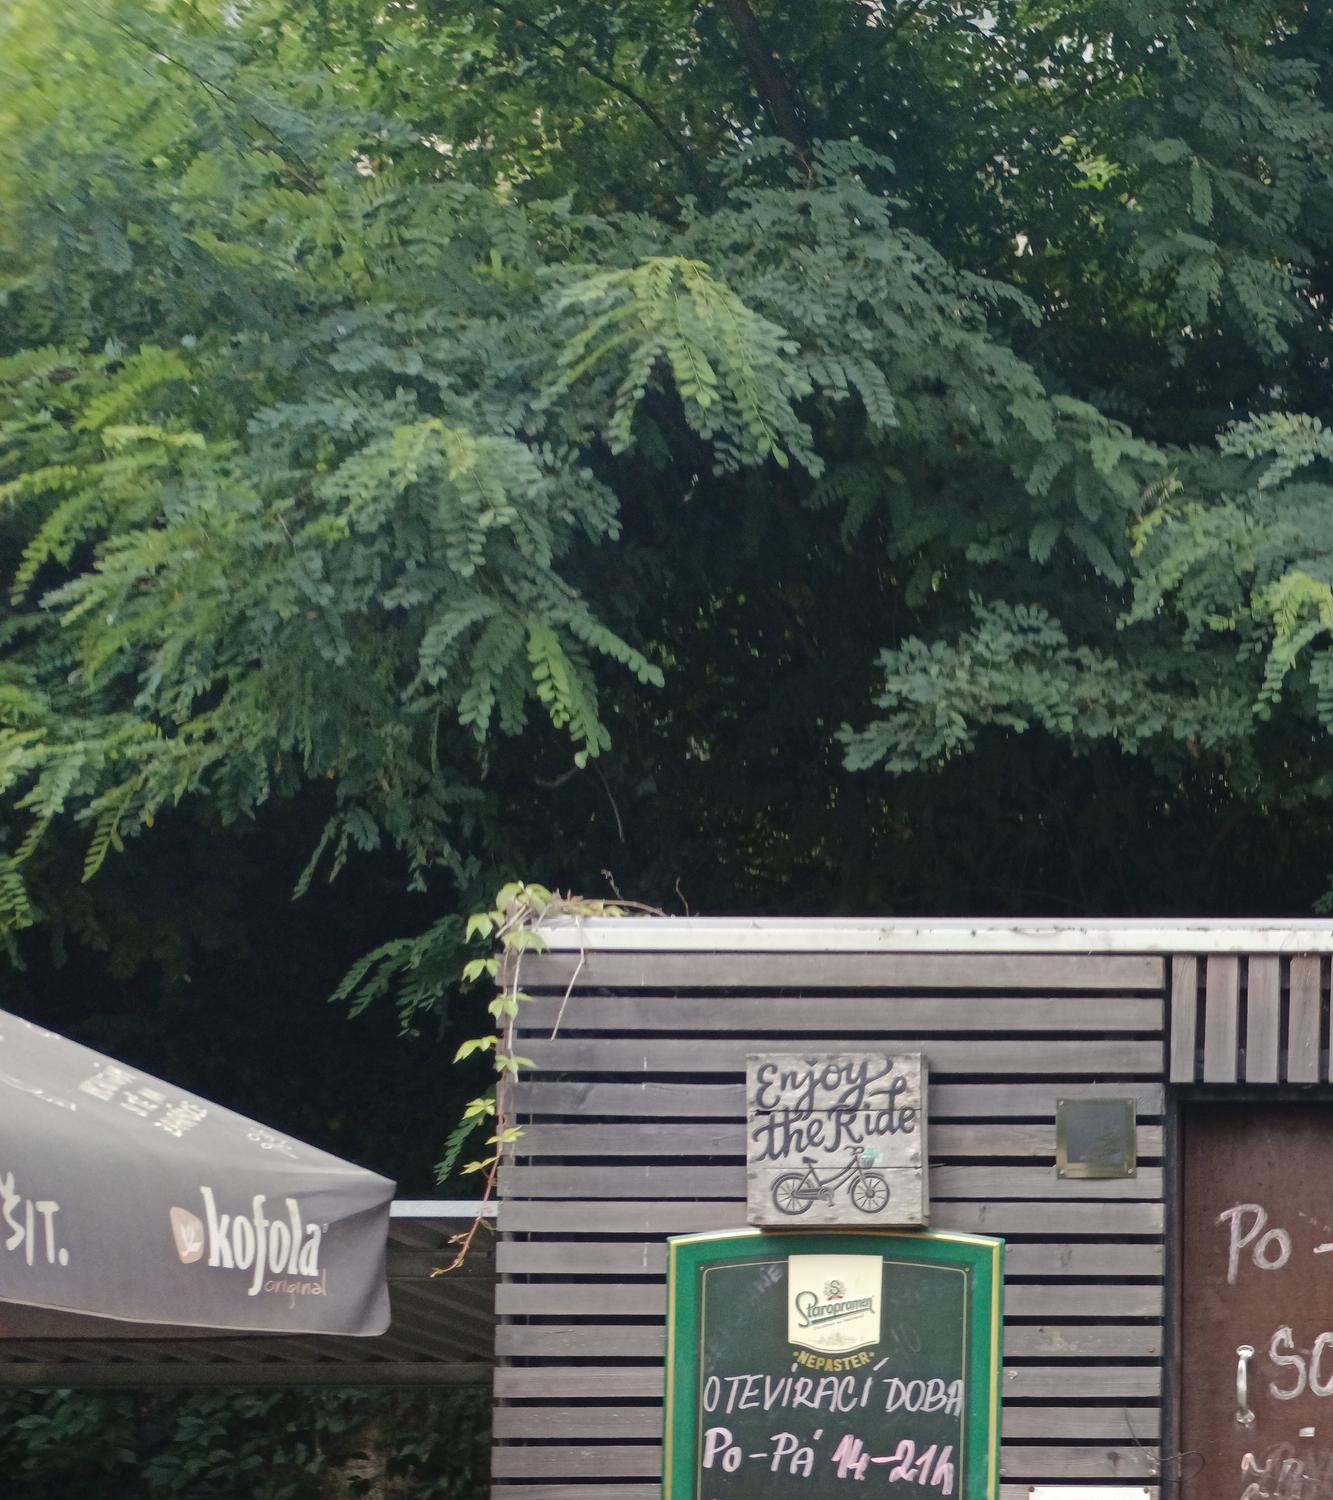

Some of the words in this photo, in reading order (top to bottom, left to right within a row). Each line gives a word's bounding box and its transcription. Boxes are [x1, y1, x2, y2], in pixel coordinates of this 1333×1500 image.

[755, 1054, 894, 1121] Enjoy
[751, 1110, 826, 1162] the
[824, 1075, 917, 1154] Ride
[199, 1186, 322, 1297] kofola
[264, 1268, 328, 1310] original
[795, 1290, 876, 1329] Staropramen
[703, 1357, 890, 1414] OTEVÍRACÍ
[882, 1377, 964, 1416] DOBA
[798, 1351, 870, 1372] NEPASTER
